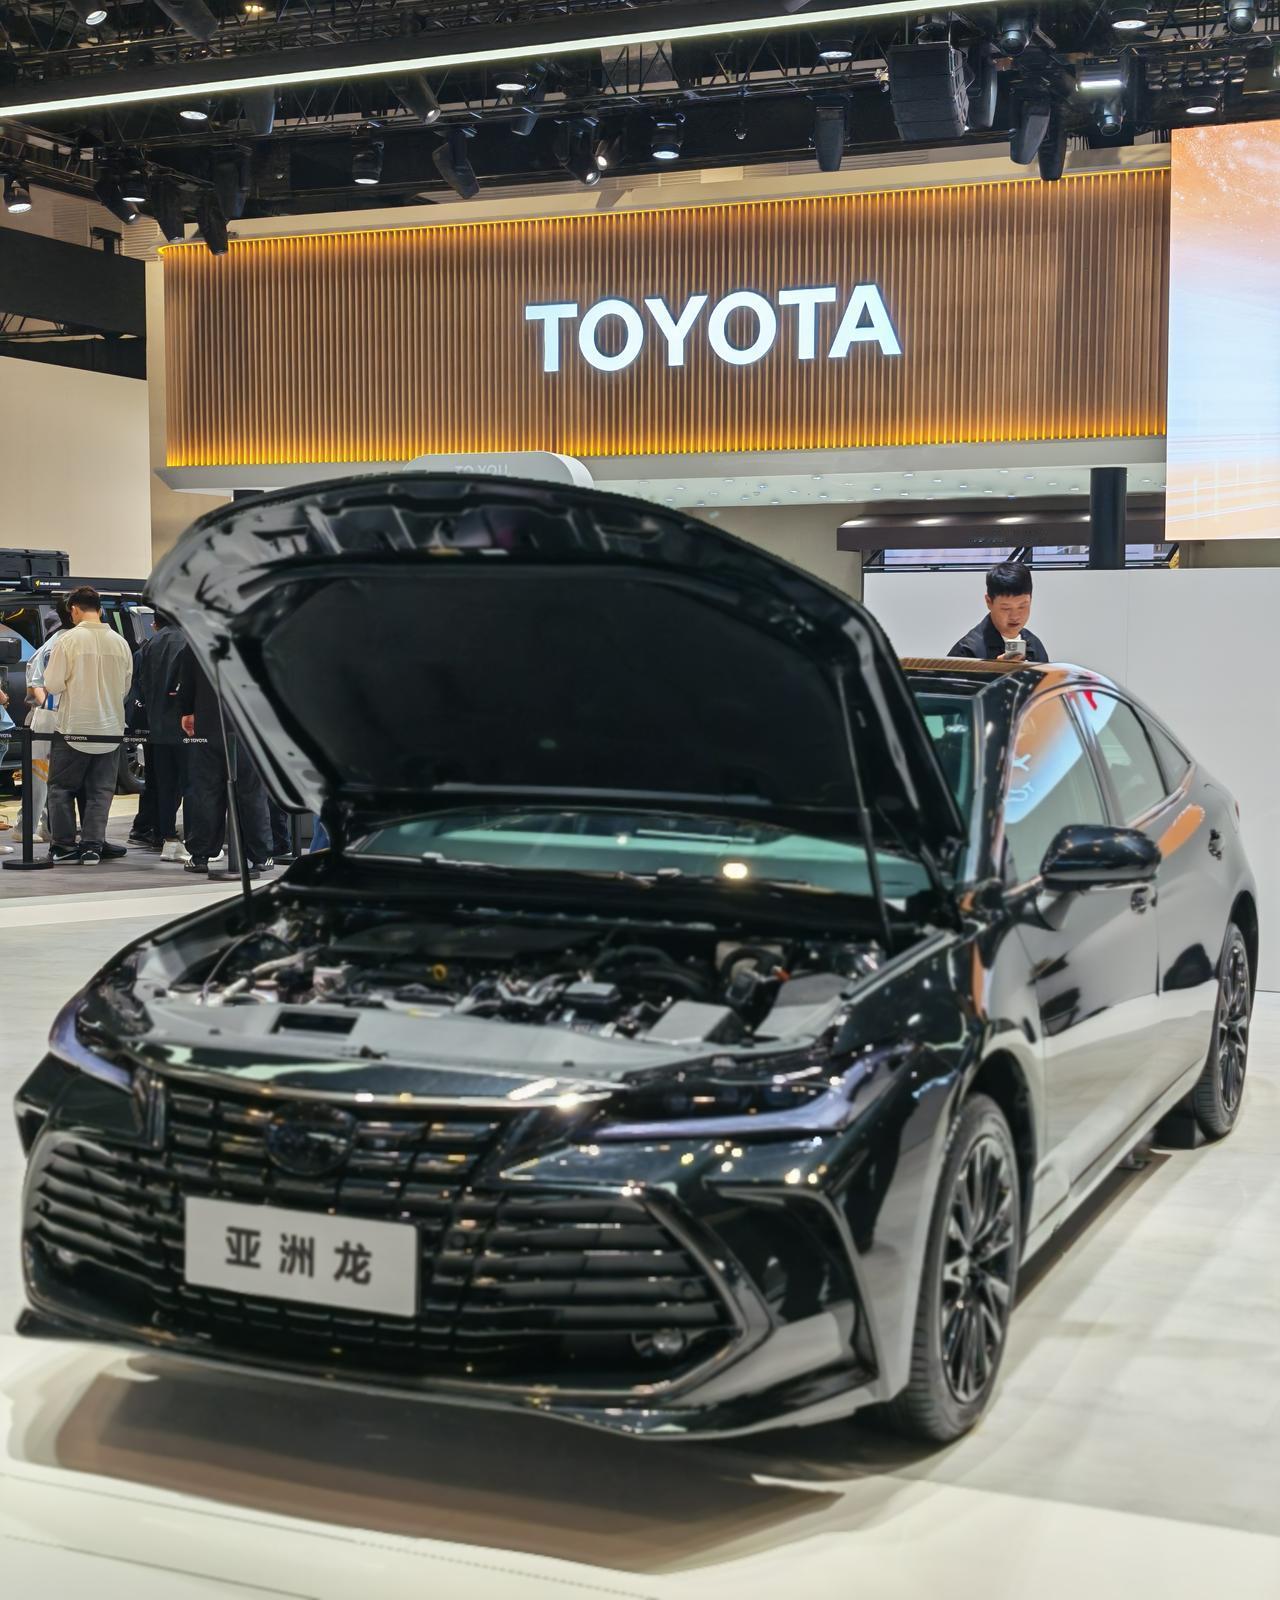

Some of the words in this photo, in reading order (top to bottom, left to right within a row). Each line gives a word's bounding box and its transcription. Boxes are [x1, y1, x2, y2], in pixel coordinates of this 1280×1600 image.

[526, 284, 901, 372] TOYOTA
[225, 1226, 373, 1285] 亚洲龙
